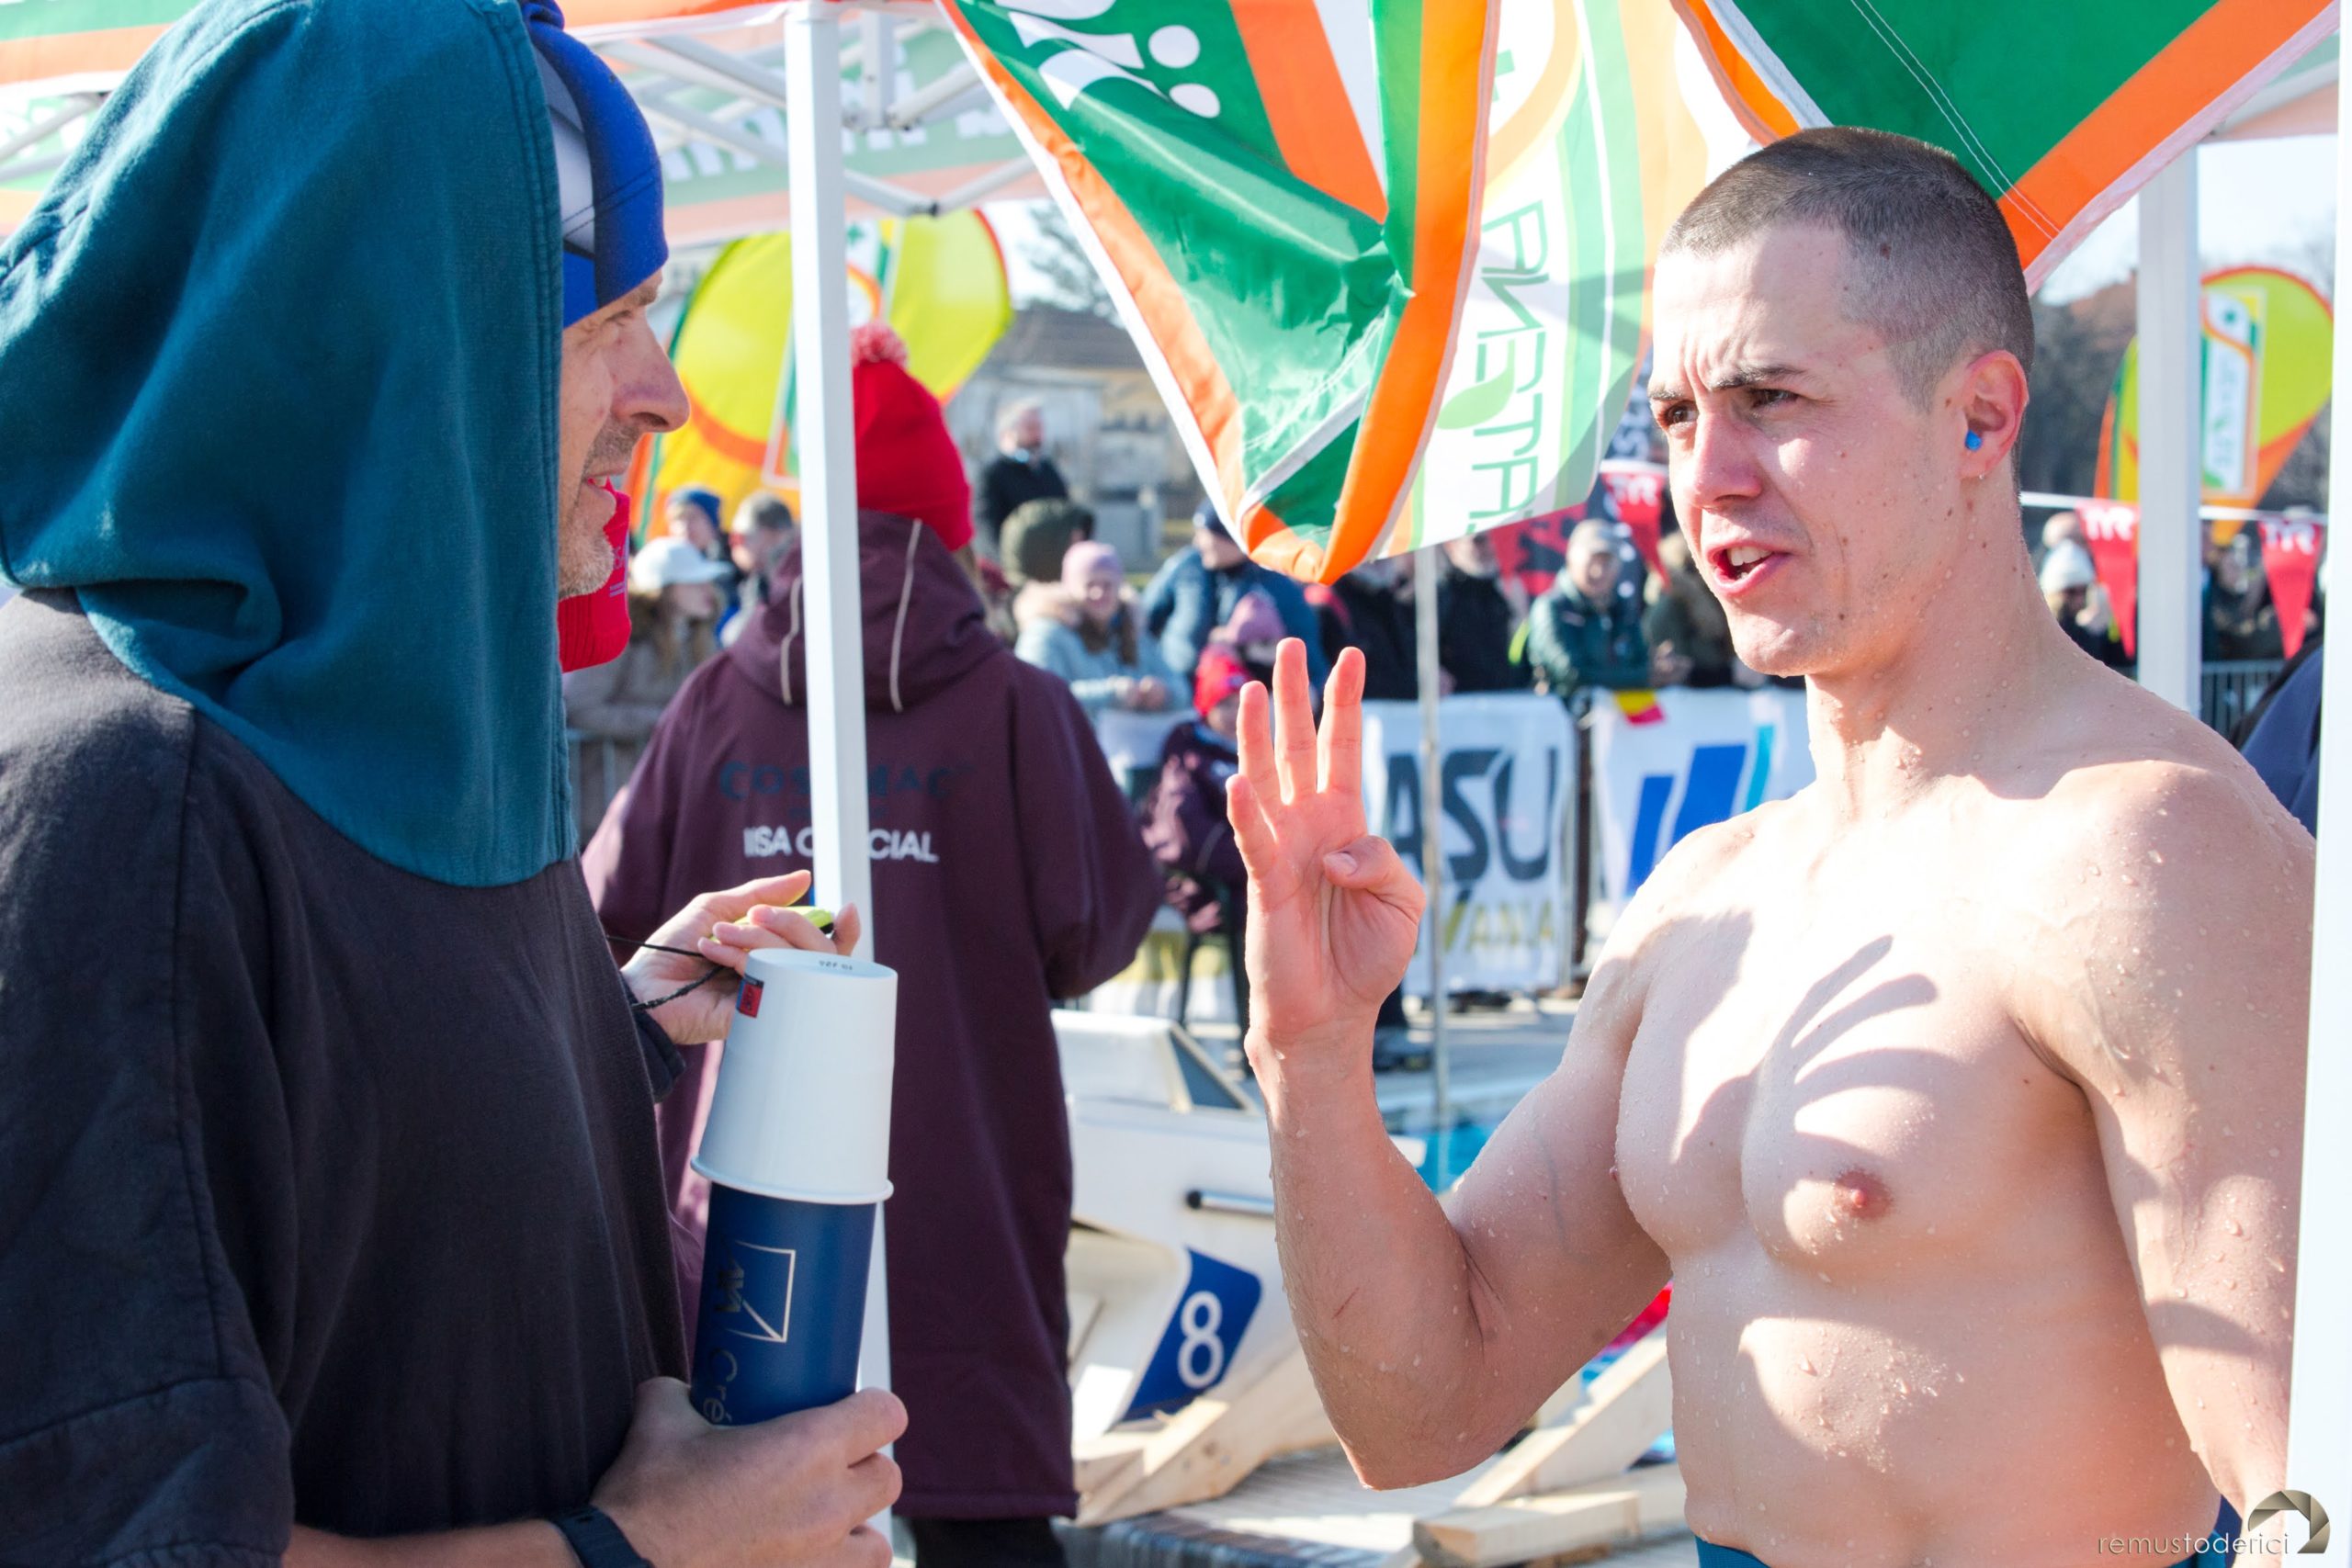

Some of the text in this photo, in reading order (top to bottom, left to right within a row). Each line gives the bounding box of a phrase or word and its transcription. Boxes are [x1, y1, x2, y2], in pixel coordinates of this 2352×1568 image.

[2083, 507, 2136, 542] TYR
[2263, 519, 2315, 556] TYR
[795, 827, 940, 863] OCIAL
[1178, 1290, 1225, 1389] 8
[702, 1348, 739, 1423] Cré
